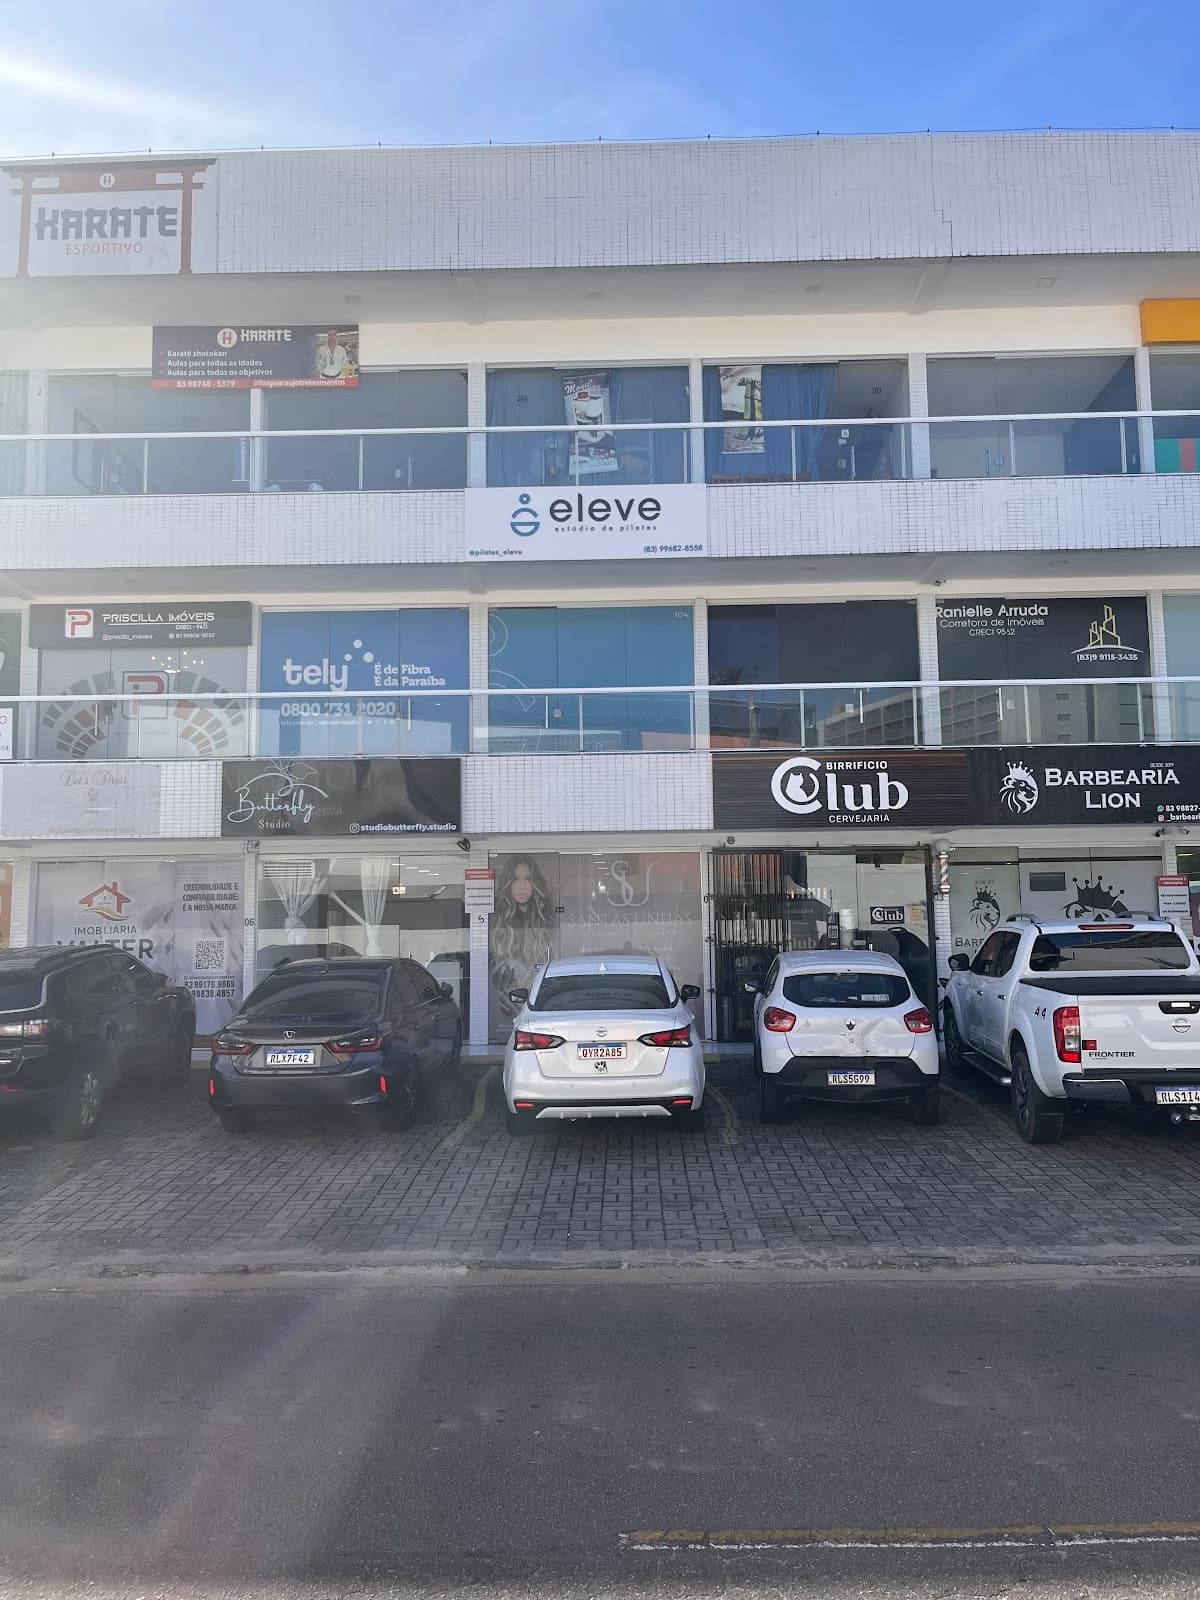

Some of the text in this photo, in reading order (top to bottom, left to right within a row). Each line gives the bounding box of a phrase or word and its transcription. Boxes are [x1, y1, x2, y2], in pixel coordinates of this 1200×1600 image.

[65, 242, 144, 256] ESPORTIVO
[193, 349, 227, 357] shotokan
[167, 359, 188, 367] Aulas
[189, 361, 205, 369] para
[206, 359, 227, 367] todas
[238, 358, 263, 367] idades
[167, 368, 188, 376] Aulas
[189, 370, 205, 378] para
[206, 368, 228, 376] todos
[239, 367, 273, 378] objetivos
[176, 380, 186, 388] 83
[216, 380, 236, 388] 5379
[549, 492, 662, 522] eleve
[602, 524, 614, 532] de
[619, 524, 657, 533] pilates
[102, 610, 215, 623] PRISCILLA IMÓVEIS
[935, 604, 1049, 618] Ranielle Arruda
[939, 617, 1045, 628] Corretora de Imóveis
[968, 628, 995, 637] CRECI
[282, 657, 348, 691] tely
[383, 664, 399, 675] de
[401, 664, 431, 675] Fibra
[383, 676, 399, 686] da
[401, 675, 446, 687] Paraíba
[280, 701, 397, 717] 0800 731 2020
[826, 760, 888, 770] BIRRIFICIO
[227, 787, 316, 823] Butterfly
[258, 818, 291, 829] Studio
[828, 814, 890, 823] CERVEJARIA
[360, 823, 457, 834] studiobutterfly.studio
[183, 882, 239, 891] CREDIBILIDADE E
[244, 918, 255, 927] 06
[270, 1054, 309, 1064] RLX7F42
[832, 1074, 870, 1084] RLS5G99
